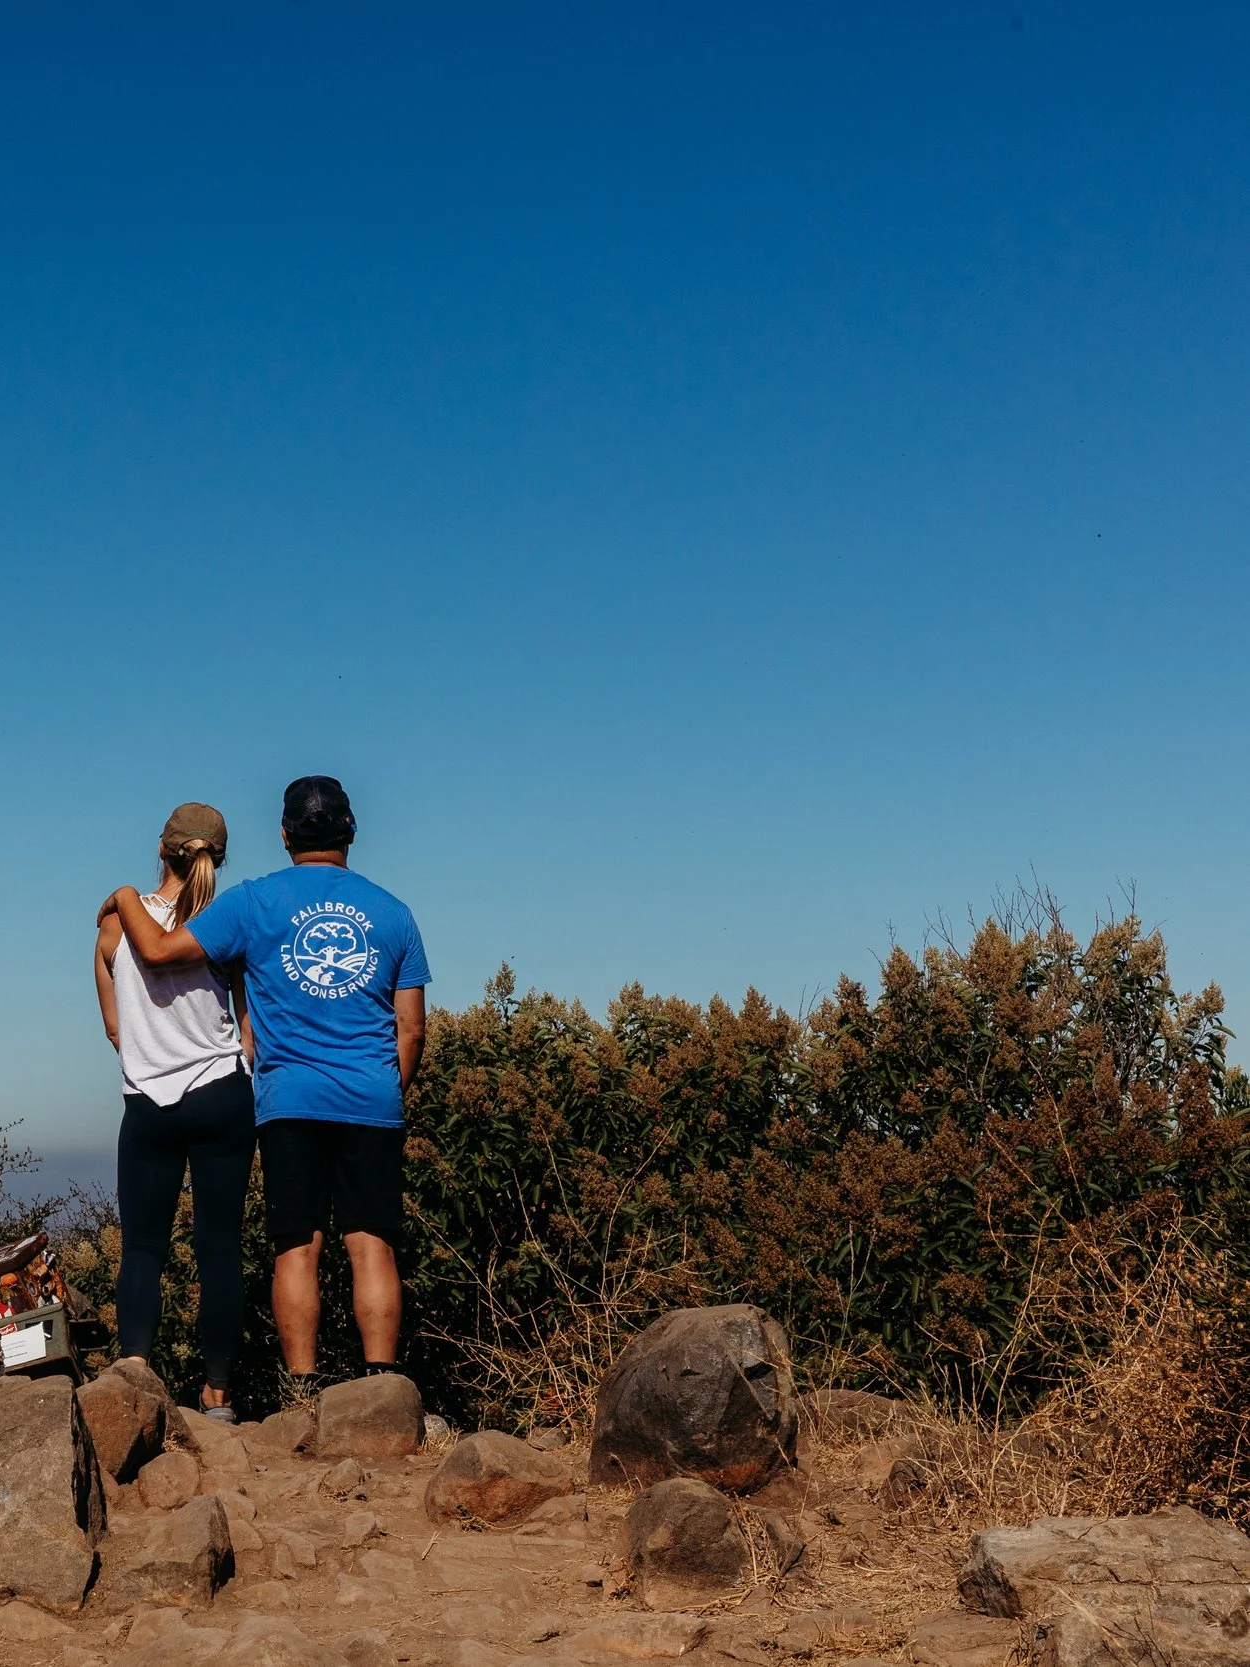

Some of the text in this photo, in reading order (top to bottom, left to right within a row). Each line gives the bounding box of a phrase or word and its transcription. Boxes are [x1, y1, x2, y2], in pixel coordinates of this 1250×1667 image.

[291, 902, 374, 932] FALLBROOK
[280, 944, 380, 1000] LAND CONSERVANCY
